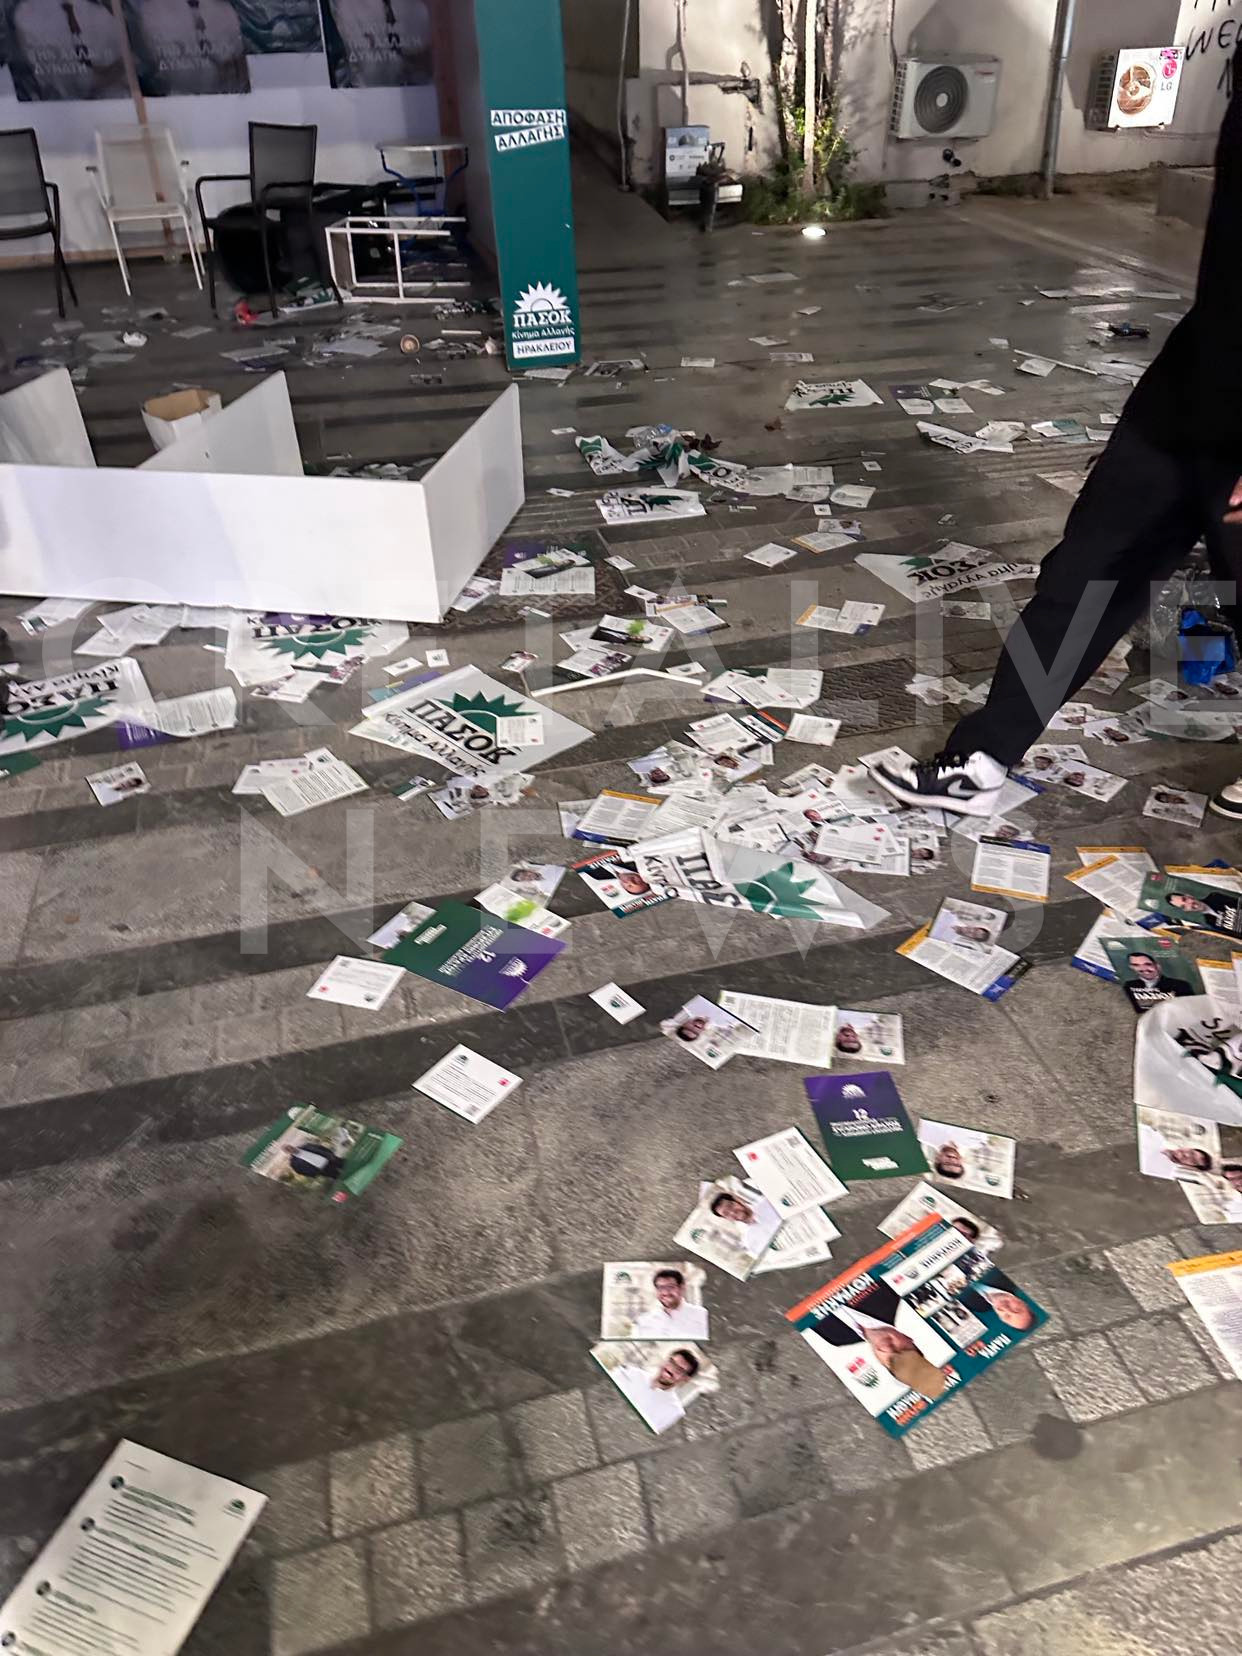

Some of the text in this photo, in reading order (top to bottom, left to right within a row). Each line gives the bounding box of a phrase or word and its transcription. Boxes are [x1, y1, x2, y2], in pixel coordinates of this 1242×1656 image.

[1160, 81, 1173, 91] LG
[492, 111, 565, 125] ΑΠΟΦΑΣΗ
[498, 124, 563, 150] ΑΛΛΑΓΗΣ
[512, 309, 572, 328] ΠΑΣΟΚ
[517, 340, 573, 355] ΗΡΑΚΛΕΙΟΥ
